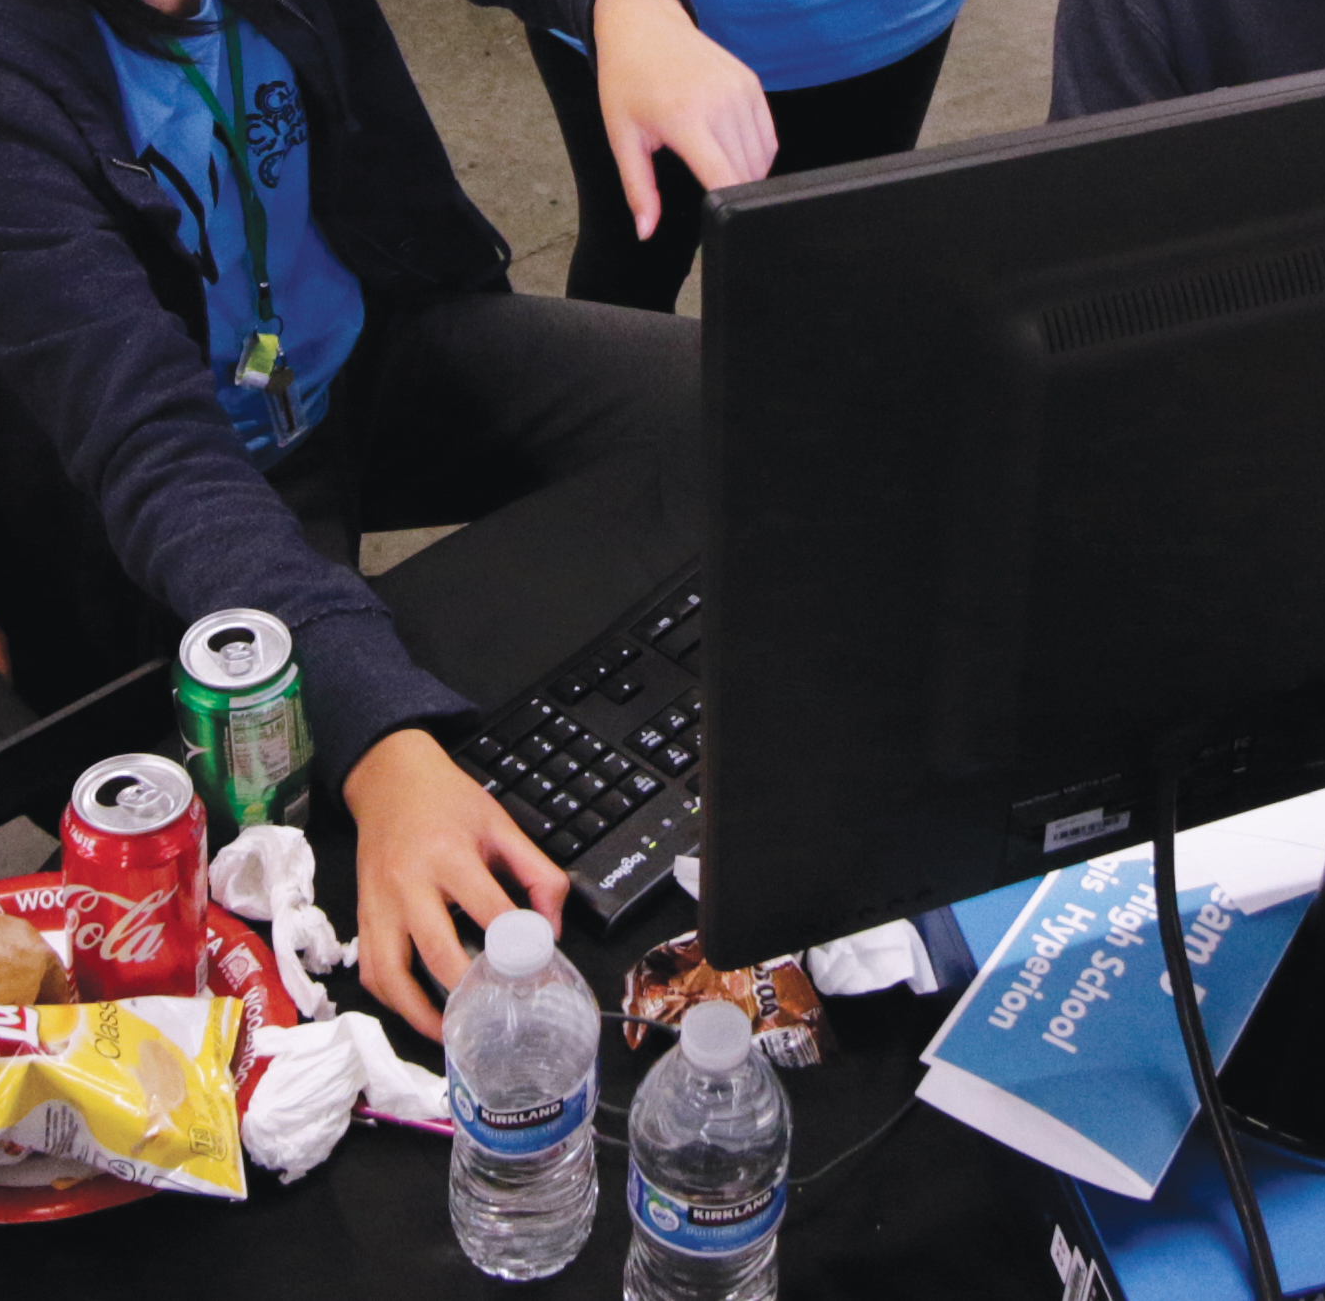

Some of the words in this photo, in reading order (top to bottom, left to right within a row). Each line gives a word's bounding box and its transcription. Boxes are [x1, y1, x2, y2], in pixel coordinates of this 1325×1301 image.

[599, 851, 647, 889] logitech
[62, 883, 180, 964] Cola
[1105, 883, 1158, 948] High
[987, 902, 1098, 1030] Hyperion
[93, 1000, 122, 1060] Class
[1041, 949, 1125, 1055] School
[480, 1101, 562, 1125] KIRKLAND
[692, 1190, 773, 1221] KIRKLAND
